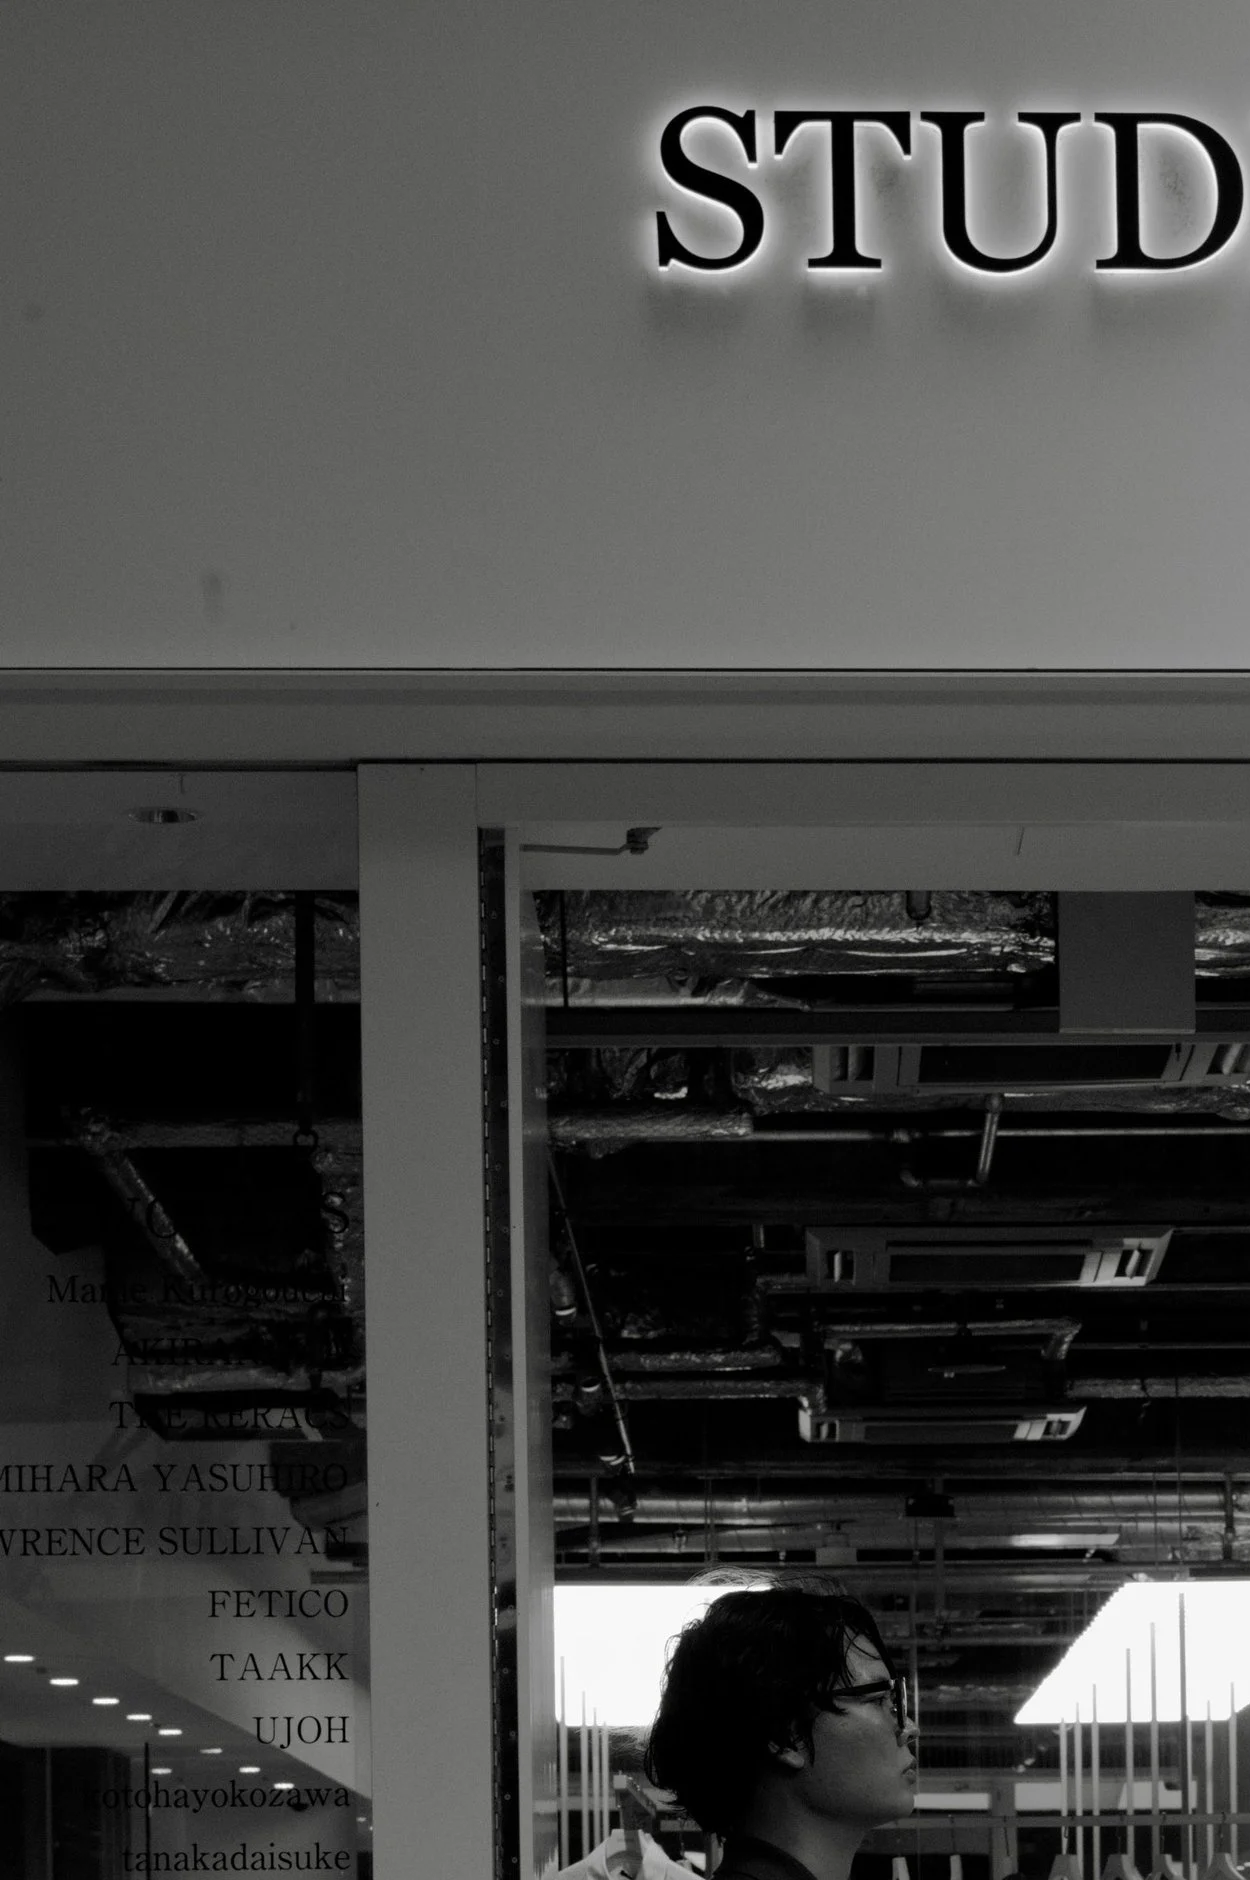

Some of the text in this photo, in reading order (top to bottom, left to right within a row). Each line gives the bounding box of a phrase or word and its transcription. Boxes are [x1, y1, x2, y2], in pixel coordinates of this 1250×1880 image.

[109, 1401, 186, 1430] TE
[153, 1462, 348, 1493] YASUHIRO
[158, 1525, 348, 1557] SULLIVAN
[208, 1588, 348, 1619] FETICO
[209, 1652, 349, 1682] TAAKK
[254, 1715, 349, 1750] UJOH
[123, 1842, 351, 1871] tanakadaisuke
